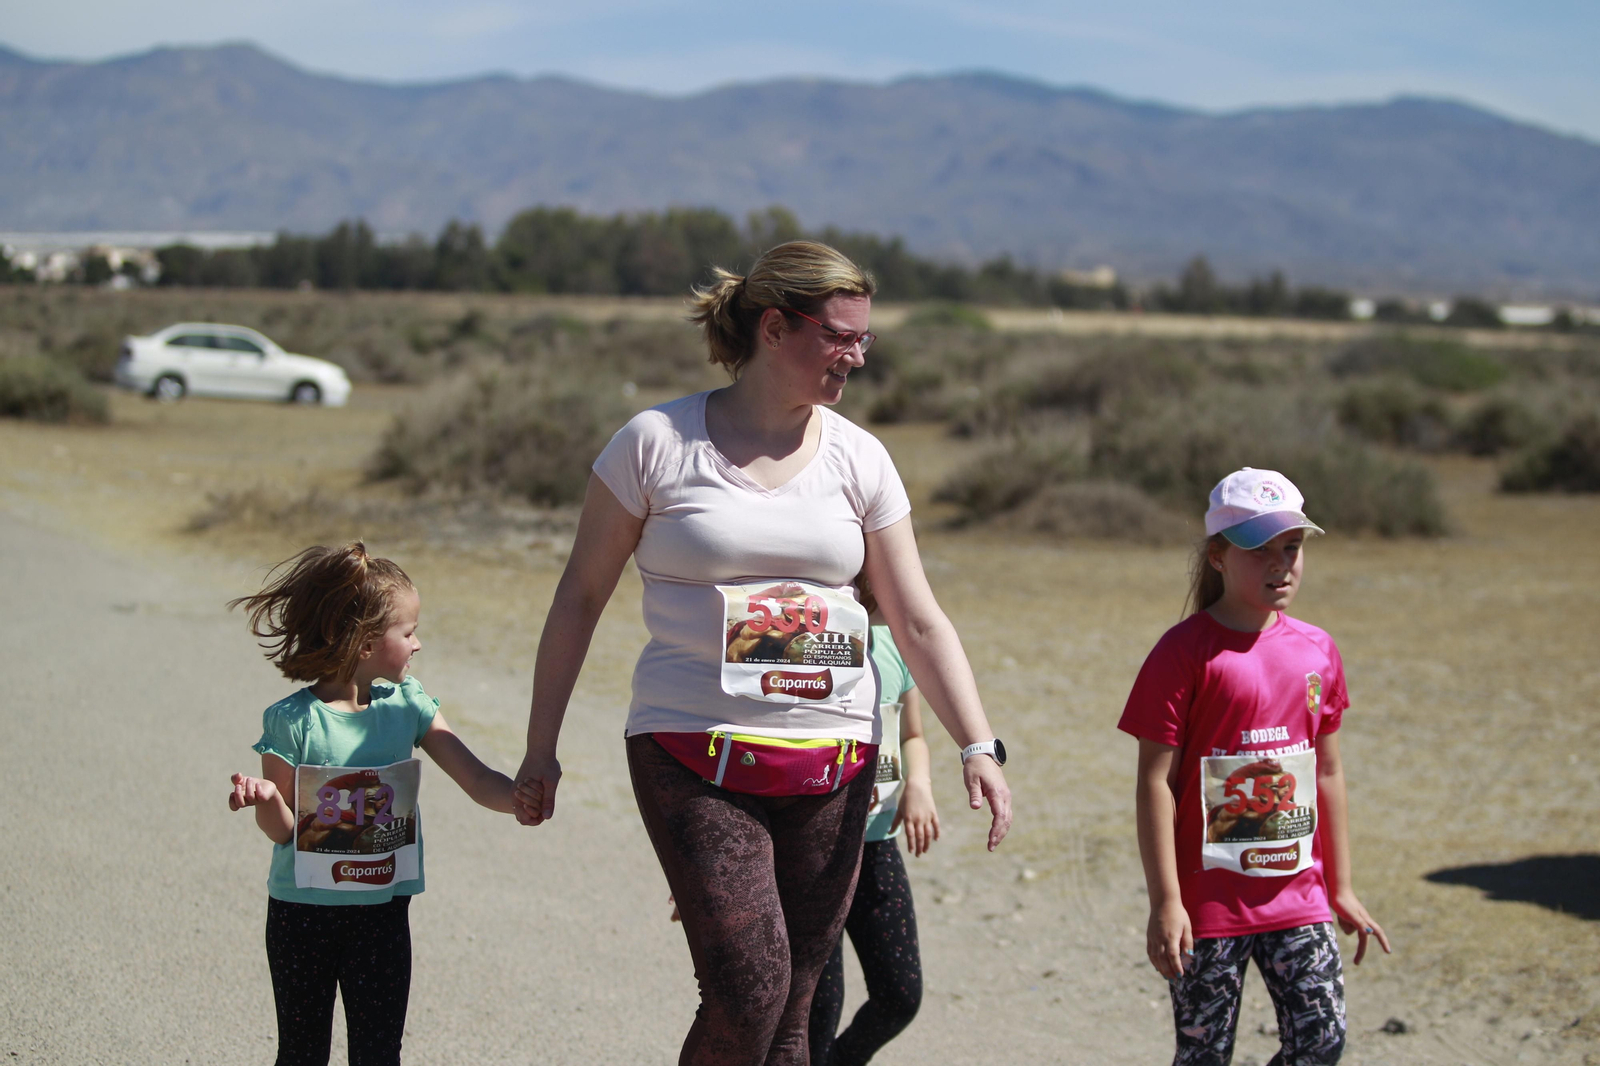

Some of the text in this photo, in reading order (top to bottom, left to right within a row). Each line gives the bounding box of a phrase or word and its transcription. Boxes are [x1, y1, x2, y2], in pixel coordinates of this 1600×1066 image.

[746, 595, 829, 633] 530
[804, 632, 852, 644] XIII
[1241, 726, 1290, 745] BODEGA
[1224, 773, 1297, 814] 552
[316, 783, 395, 826] 812
[1279, 806, 1311, 819] XIII
[374, 817, 407, 833] XIII
